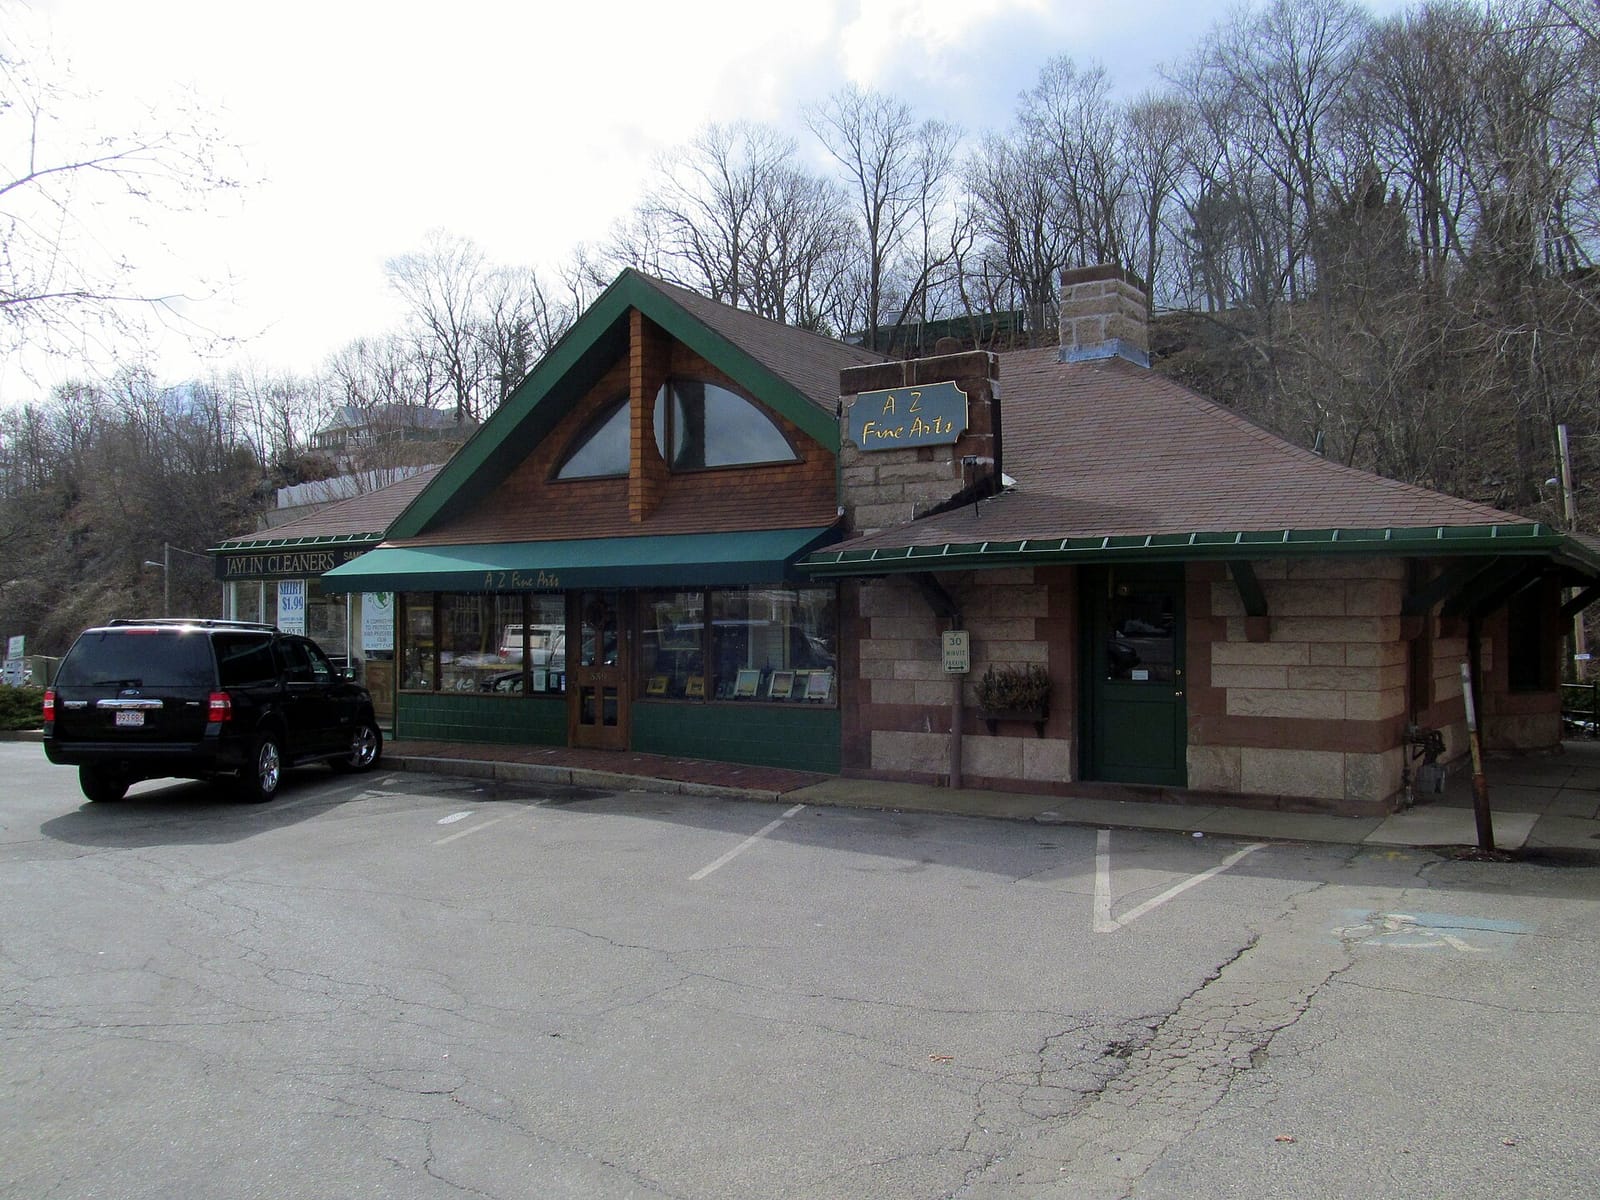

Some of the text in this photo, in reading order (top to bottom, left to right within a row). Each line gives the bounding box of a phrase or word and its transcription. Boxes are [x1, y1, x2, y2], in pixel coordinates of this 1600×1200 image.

[882, 391, 922, 416] A Z
[862, 415, 954, 445] Fine Arts
[225, 552, 336, 576] JAYLIN CLEANERS
[279, 581, 303, 595] SHIRT
[484, 570, 560, 589] A Z Fine Arts
[282, 596, 304, 610] $1.99
[949, 637, 962, 646] 30
